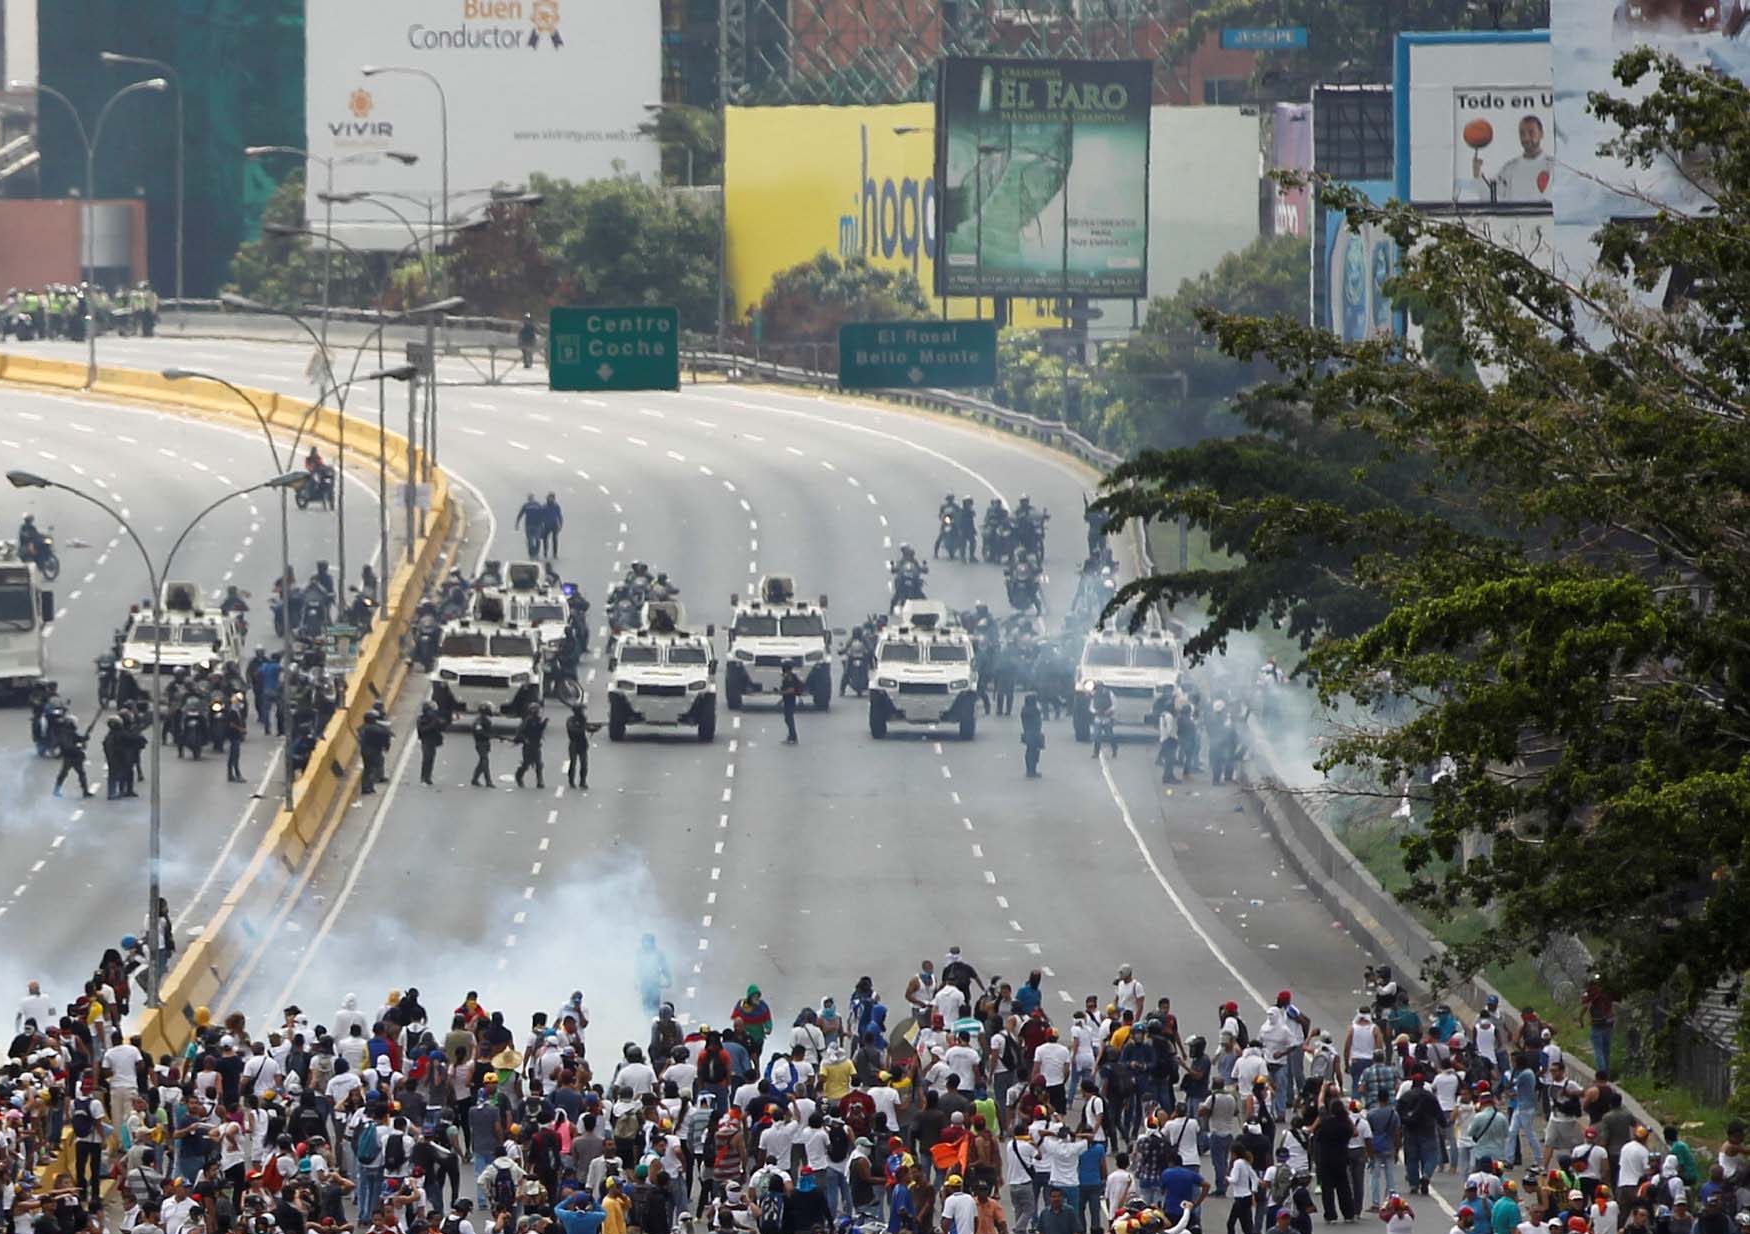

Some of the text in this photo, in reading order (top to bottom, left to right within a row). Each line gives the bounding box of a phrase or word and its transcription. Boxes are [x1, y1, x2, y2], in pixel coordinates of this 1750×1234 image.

[464, 0, 522, 19] Buen
[408, 23, 524, 49] Conductor
[1000, 79, 1129, 110] EL FARO
[1457, 95, 1504, 109] Todo
[1511, 98, 1536, 108] en
[328, 122, 393, 137] VIVIR
[587, 315, 670, 333] Centro
[878, 328, 957, 344] El Rosal
